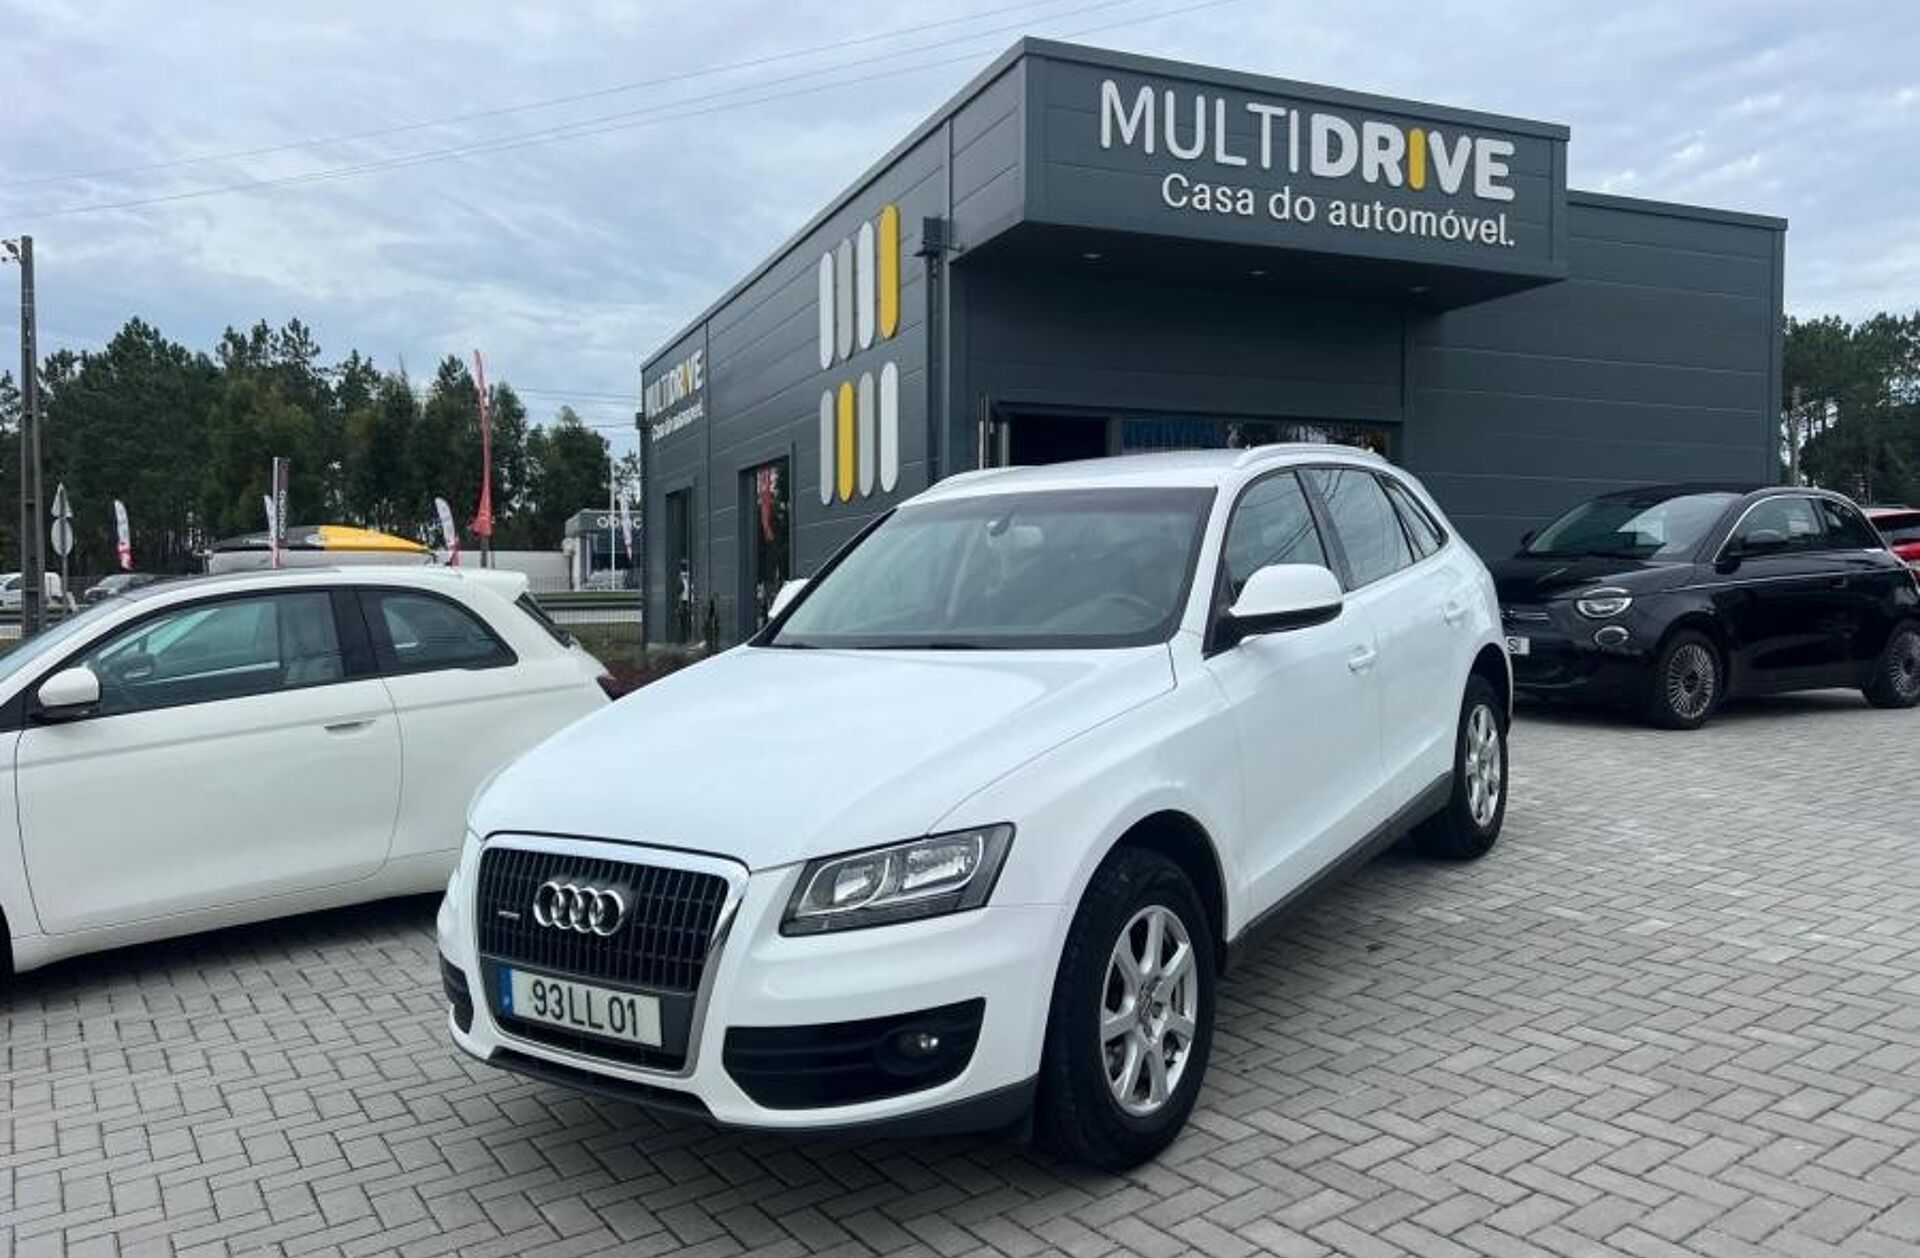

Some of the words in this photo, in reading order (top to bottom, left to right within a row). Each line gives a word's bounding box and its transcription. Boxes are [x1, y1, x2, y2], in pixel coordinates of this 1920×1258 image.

[1101, 79, 1515, 201] MULTIDRIVE
[1161, 172, 1254, 216] Casa
[1268, 186, 1316, 223] do
[1328, 199, 1516, 247] automóvel.
